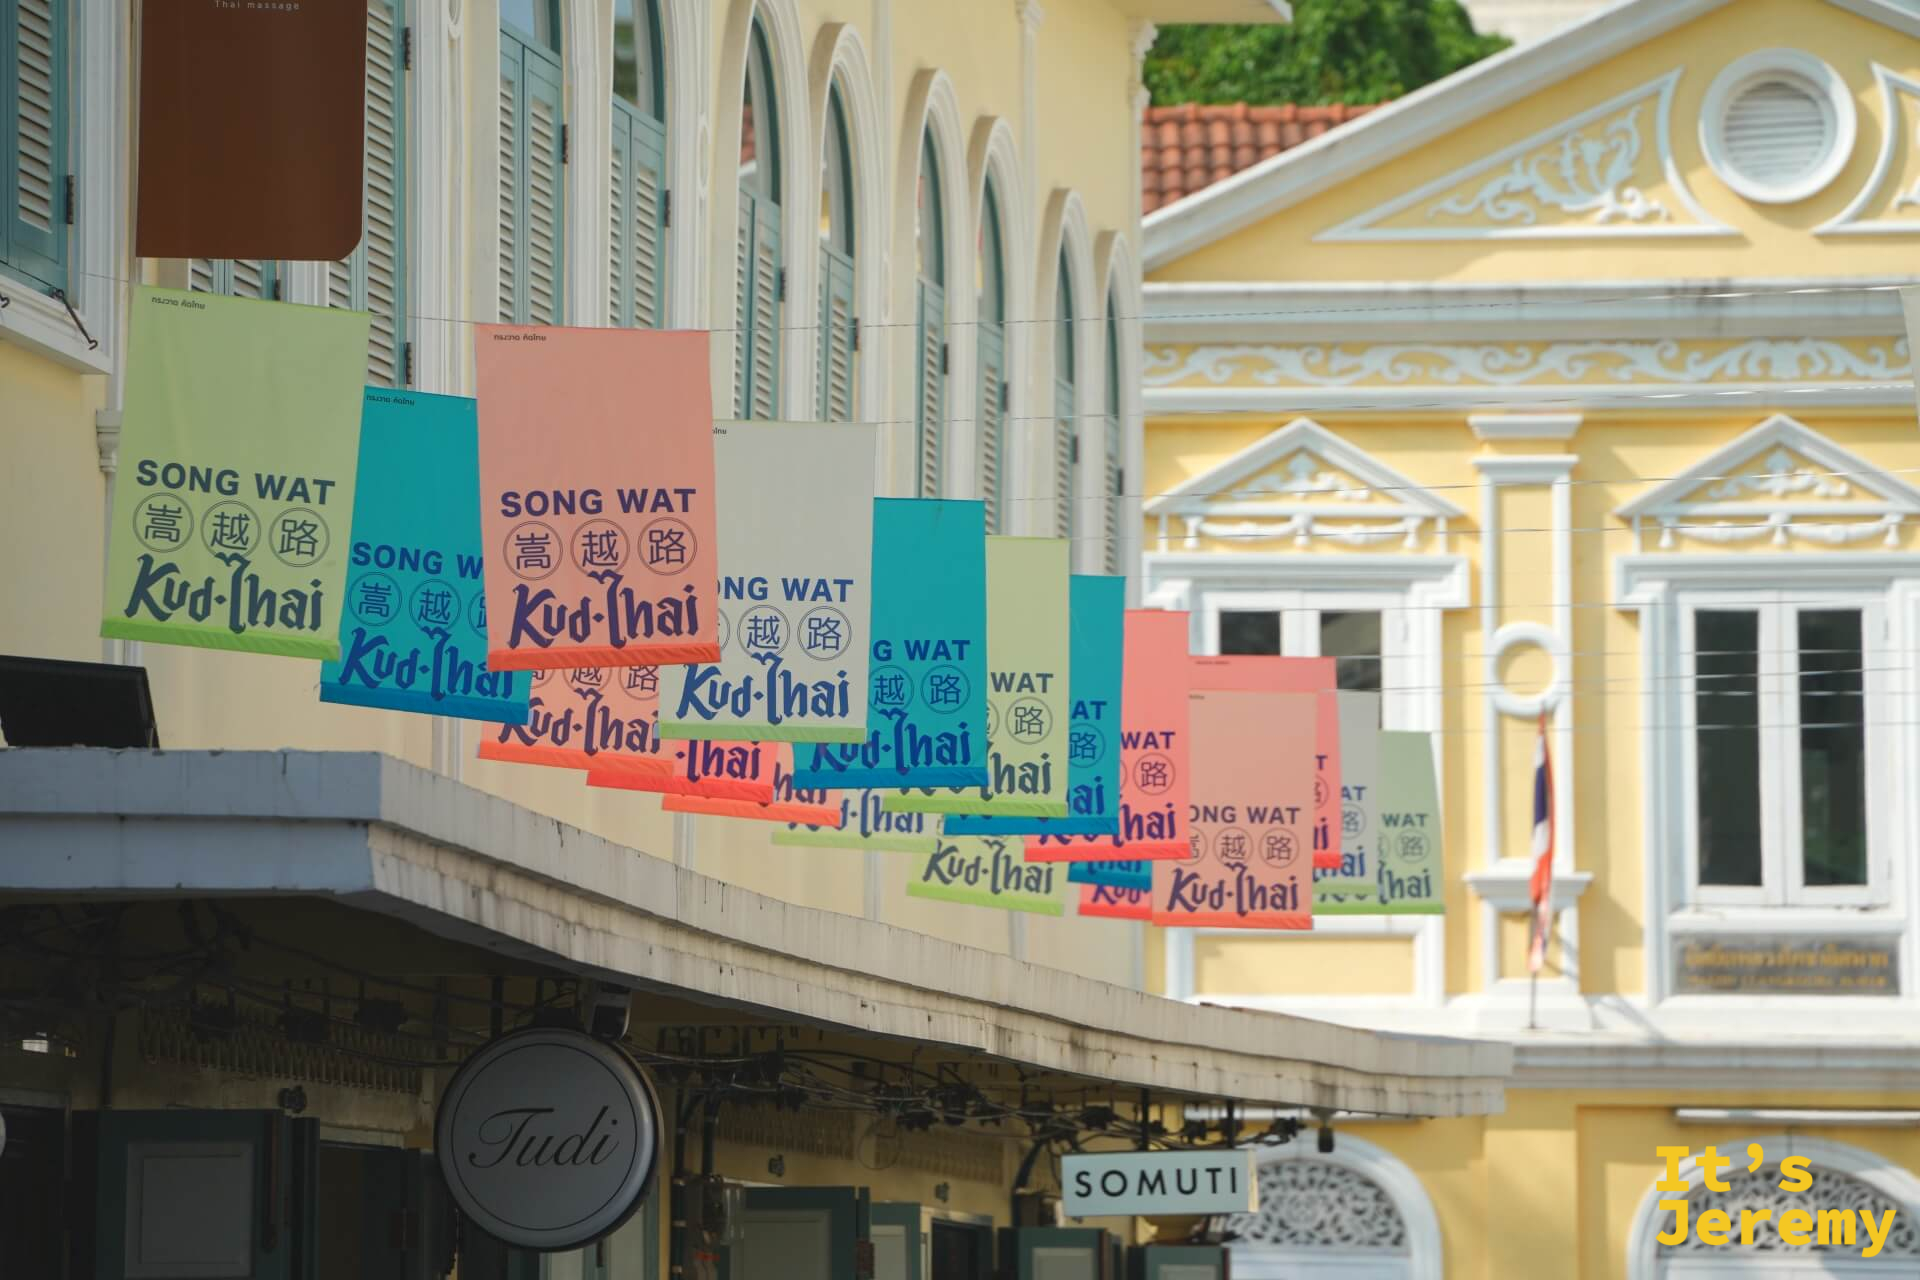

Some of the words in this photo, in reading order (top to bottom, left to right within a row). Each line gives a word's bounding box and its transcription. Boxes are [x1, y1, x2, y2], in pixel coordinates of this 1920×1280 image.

[215, 0, 241, 9] Thai
[247, 1, 300, 11] massage
[136, 459, 240, 496] SONG
[254, 472, 336, 505] WAT
[500, 488, 604, 518] SONG
[616, 488, 697, 514] WAT
[351, 541, 443, 575] SONG
[717, 576, 769, 601] NG
[781, 577, 854, 603] WAT
[904, 639, 971, 662] WAT
[990, 671, 1054, 694] WAT
[1071, 700, 1108, 720] AT
[1121, 731, 1176, 750] WAT
[1341, 785, 1367, 801] AT
[1189, 804, 1237, 825] ONG
[1246, 806, 1301, 825] WAT
[1382, 813, 1428, 828] WAT
[468, 1105, 620, 1169] Tudi
[1075, 1167, 1237, 1198] SOMUTI
